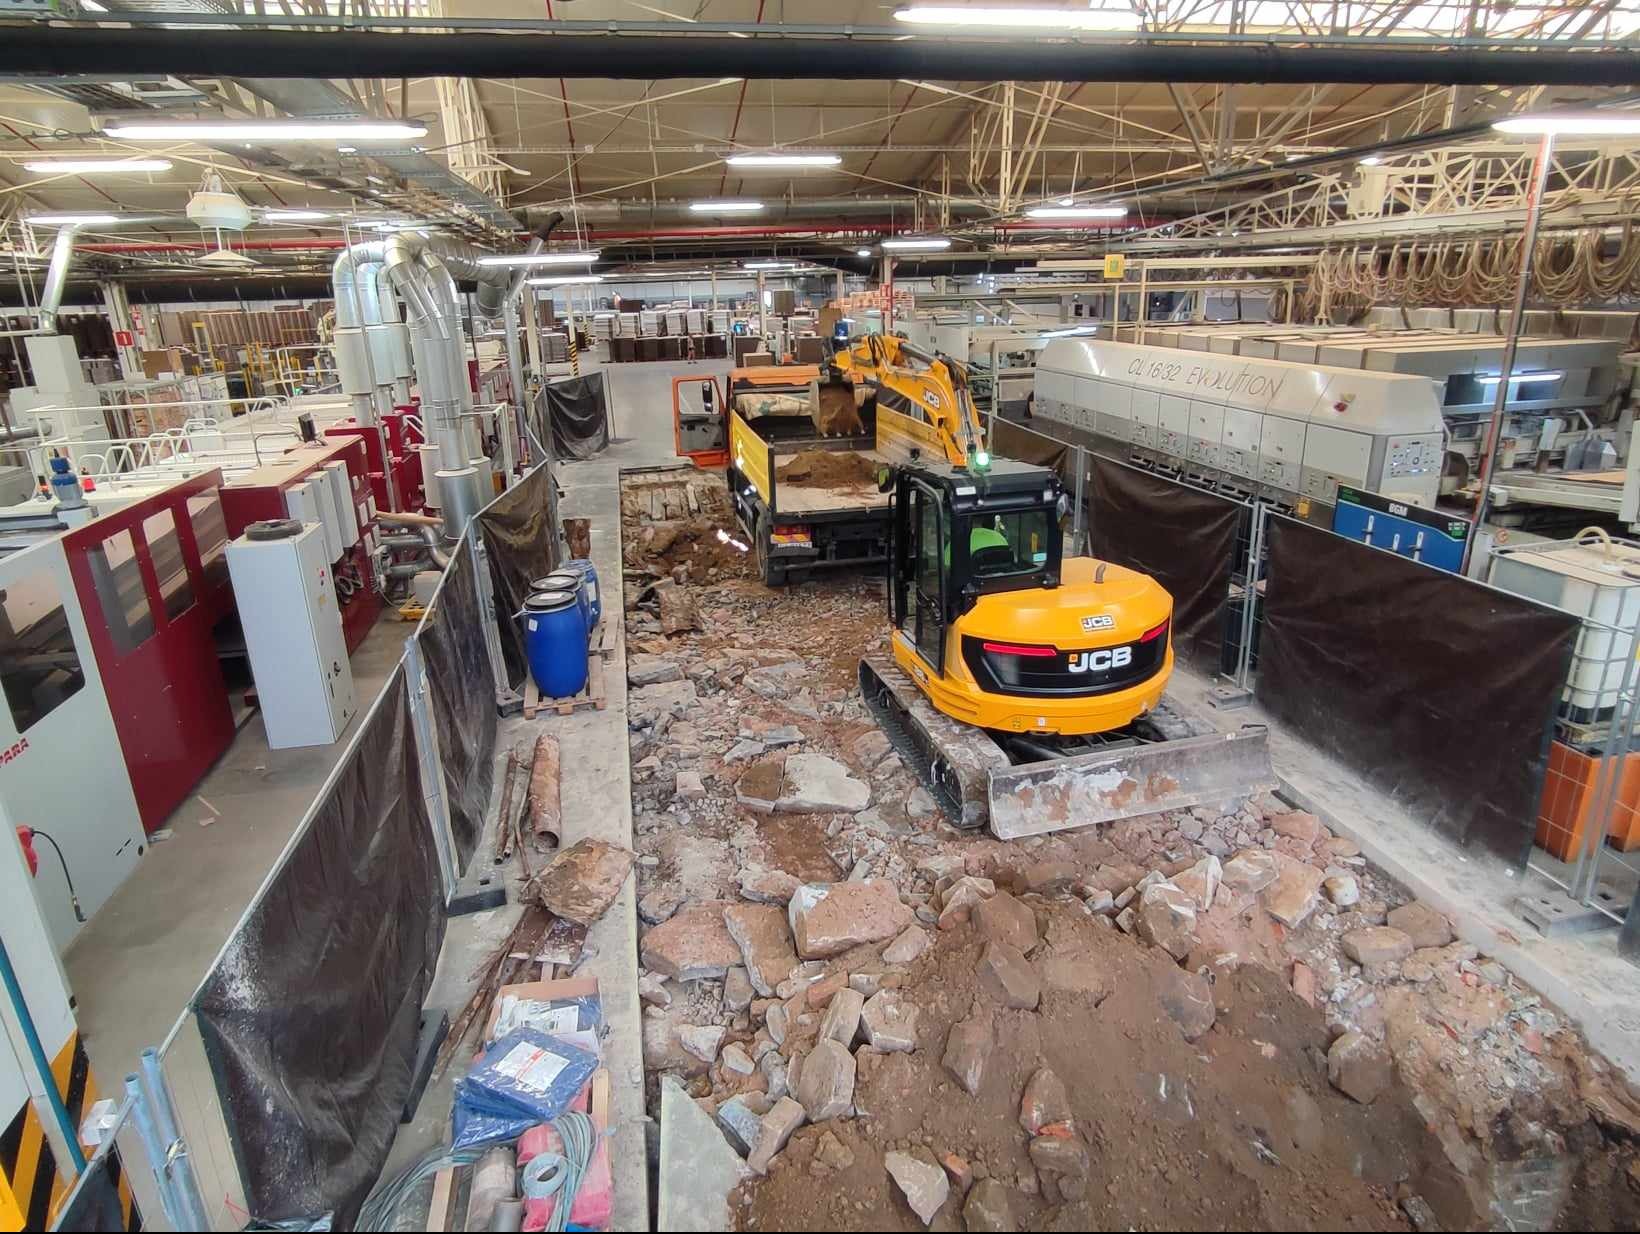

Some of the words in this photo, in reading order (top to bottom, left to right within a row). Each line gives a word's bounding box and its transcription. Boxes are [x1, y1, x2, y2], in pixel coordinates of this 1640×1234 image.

[1185, 365, 1284, 398] EVOLUTION
[923, 390, 940, 409] JCB
[1082, 616, 1113, 628] JCB
[1068, 646, 1132, 673] JCB
